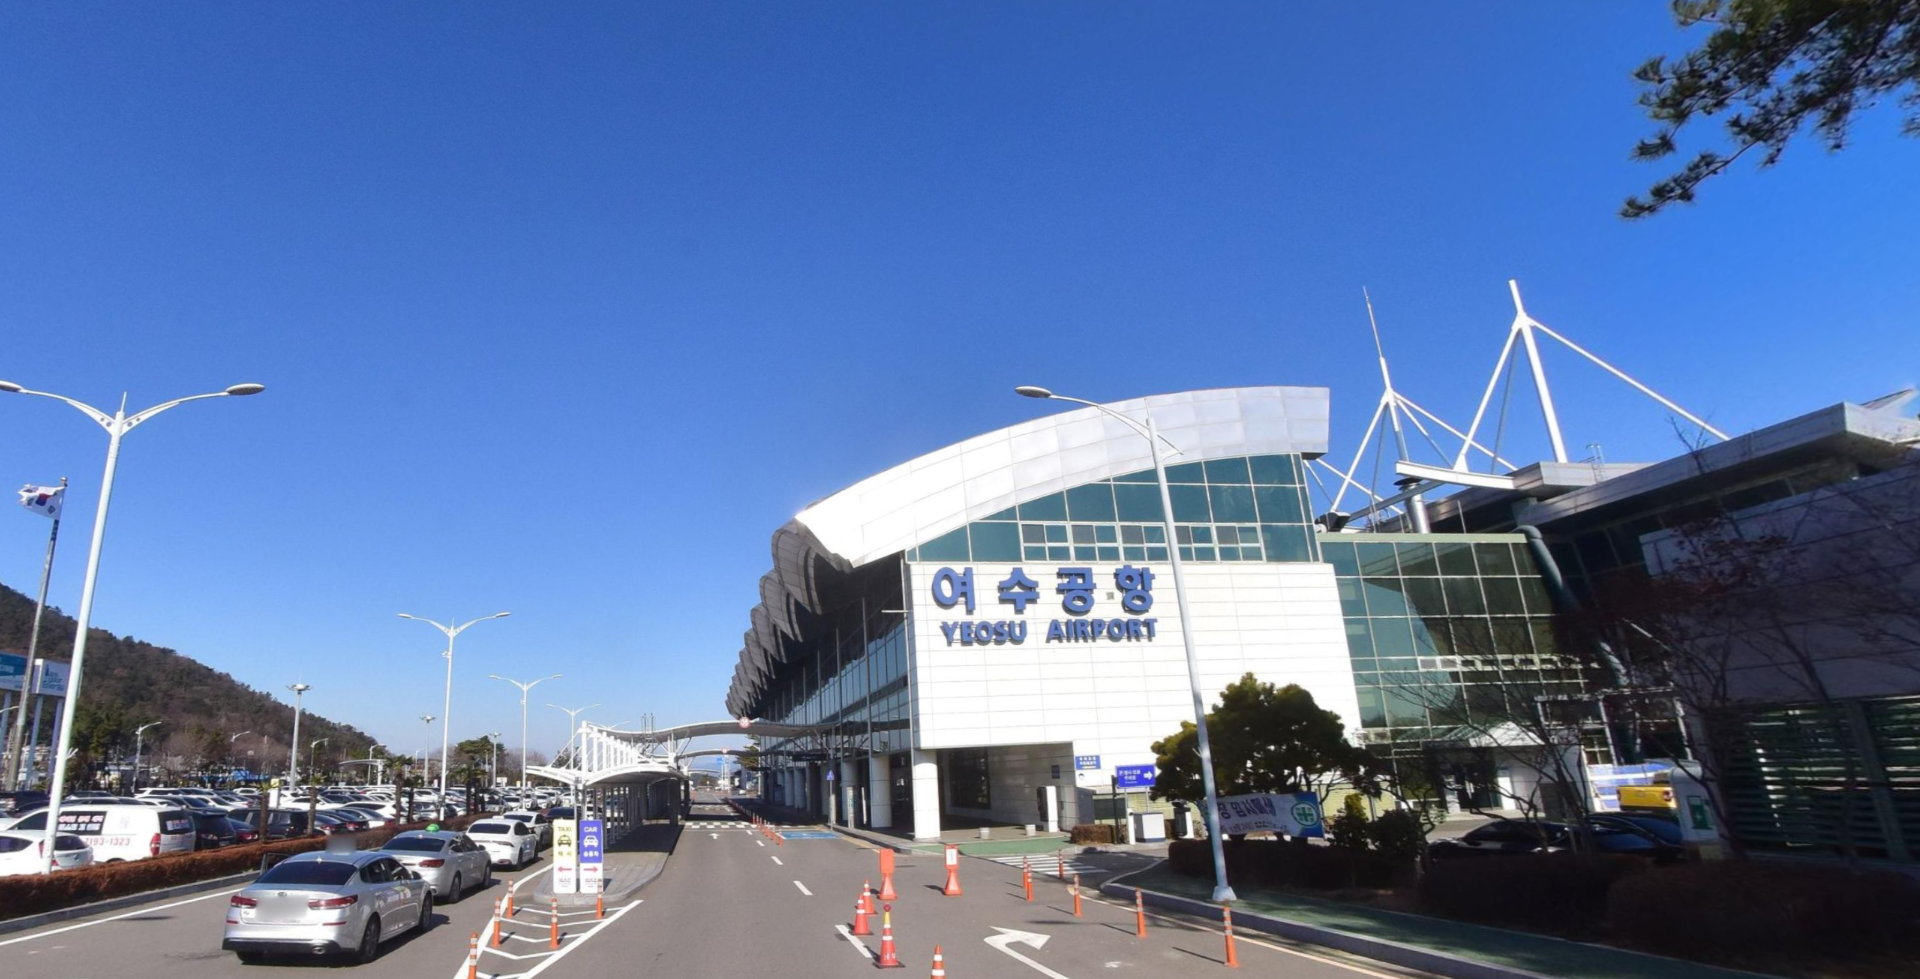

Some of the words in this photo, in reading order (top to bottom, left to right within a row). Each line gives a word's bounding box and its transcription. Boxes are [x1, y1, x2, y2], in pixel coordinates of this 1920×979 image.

[932, 564, 1155, 616] 여수공항
[941, 620, 1028, 646] YEOSU
[1046, 618, 1158, 643] AIRPORT
